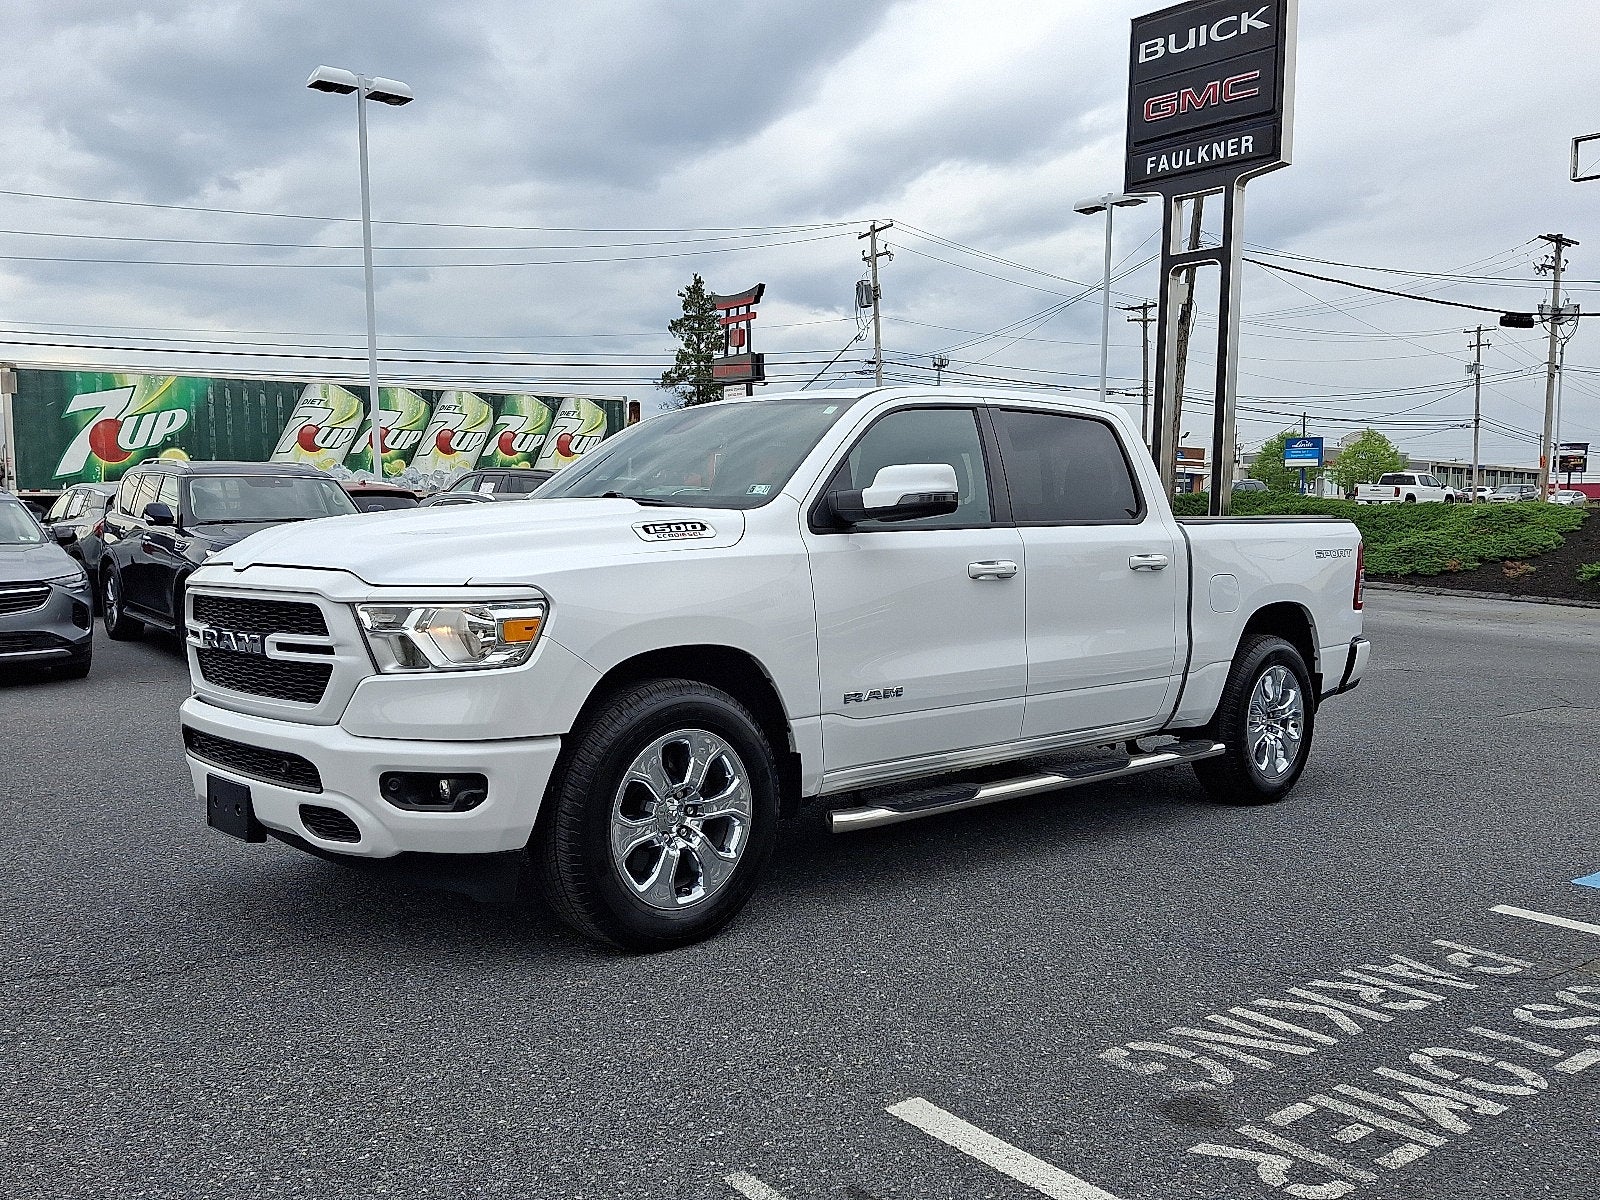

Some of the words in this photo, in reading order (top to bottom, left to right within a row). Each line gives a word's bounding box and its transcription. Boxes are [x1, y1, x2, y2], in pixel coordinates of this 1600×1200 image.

[1138, 5, 1272, 64] BUICK
[1143, 69, 1260, 122] GMC
[1146, 135, 1254, 175] FAULKNER
[301, 398, 327, 406] DIET
[438, 404, 460, 412] DIET
[645, 522, 702, 534] 1500
[1314, 549, 1352, 559] SPORT
[202, 627, 264, 655] RAM
[843, 685, 904, 705] RAM
[1098, 938, 1535, 1090] PARKING
